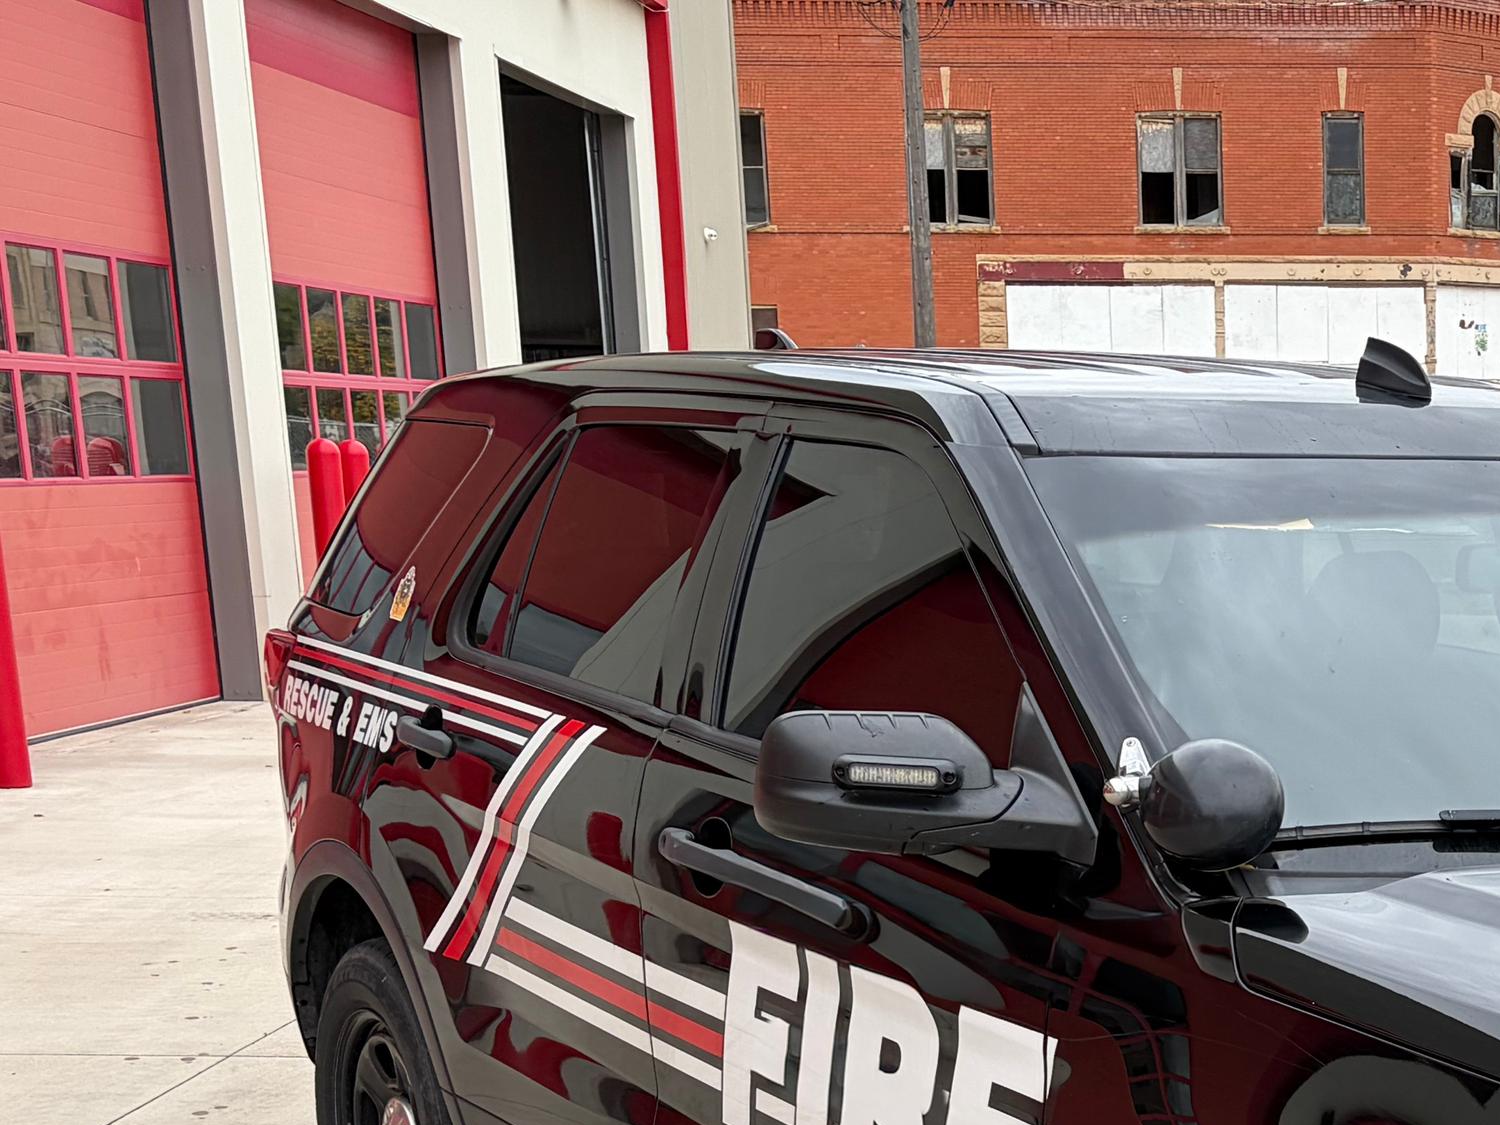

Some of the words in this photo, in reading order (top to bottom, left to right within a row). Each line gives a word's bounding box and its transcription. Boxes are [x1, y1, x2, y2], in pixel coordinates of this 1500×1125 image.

[283, 674, 340, 731] RESCUE
[336, 696, 353, 737] &
[352, 702, 398, 753] EMS
